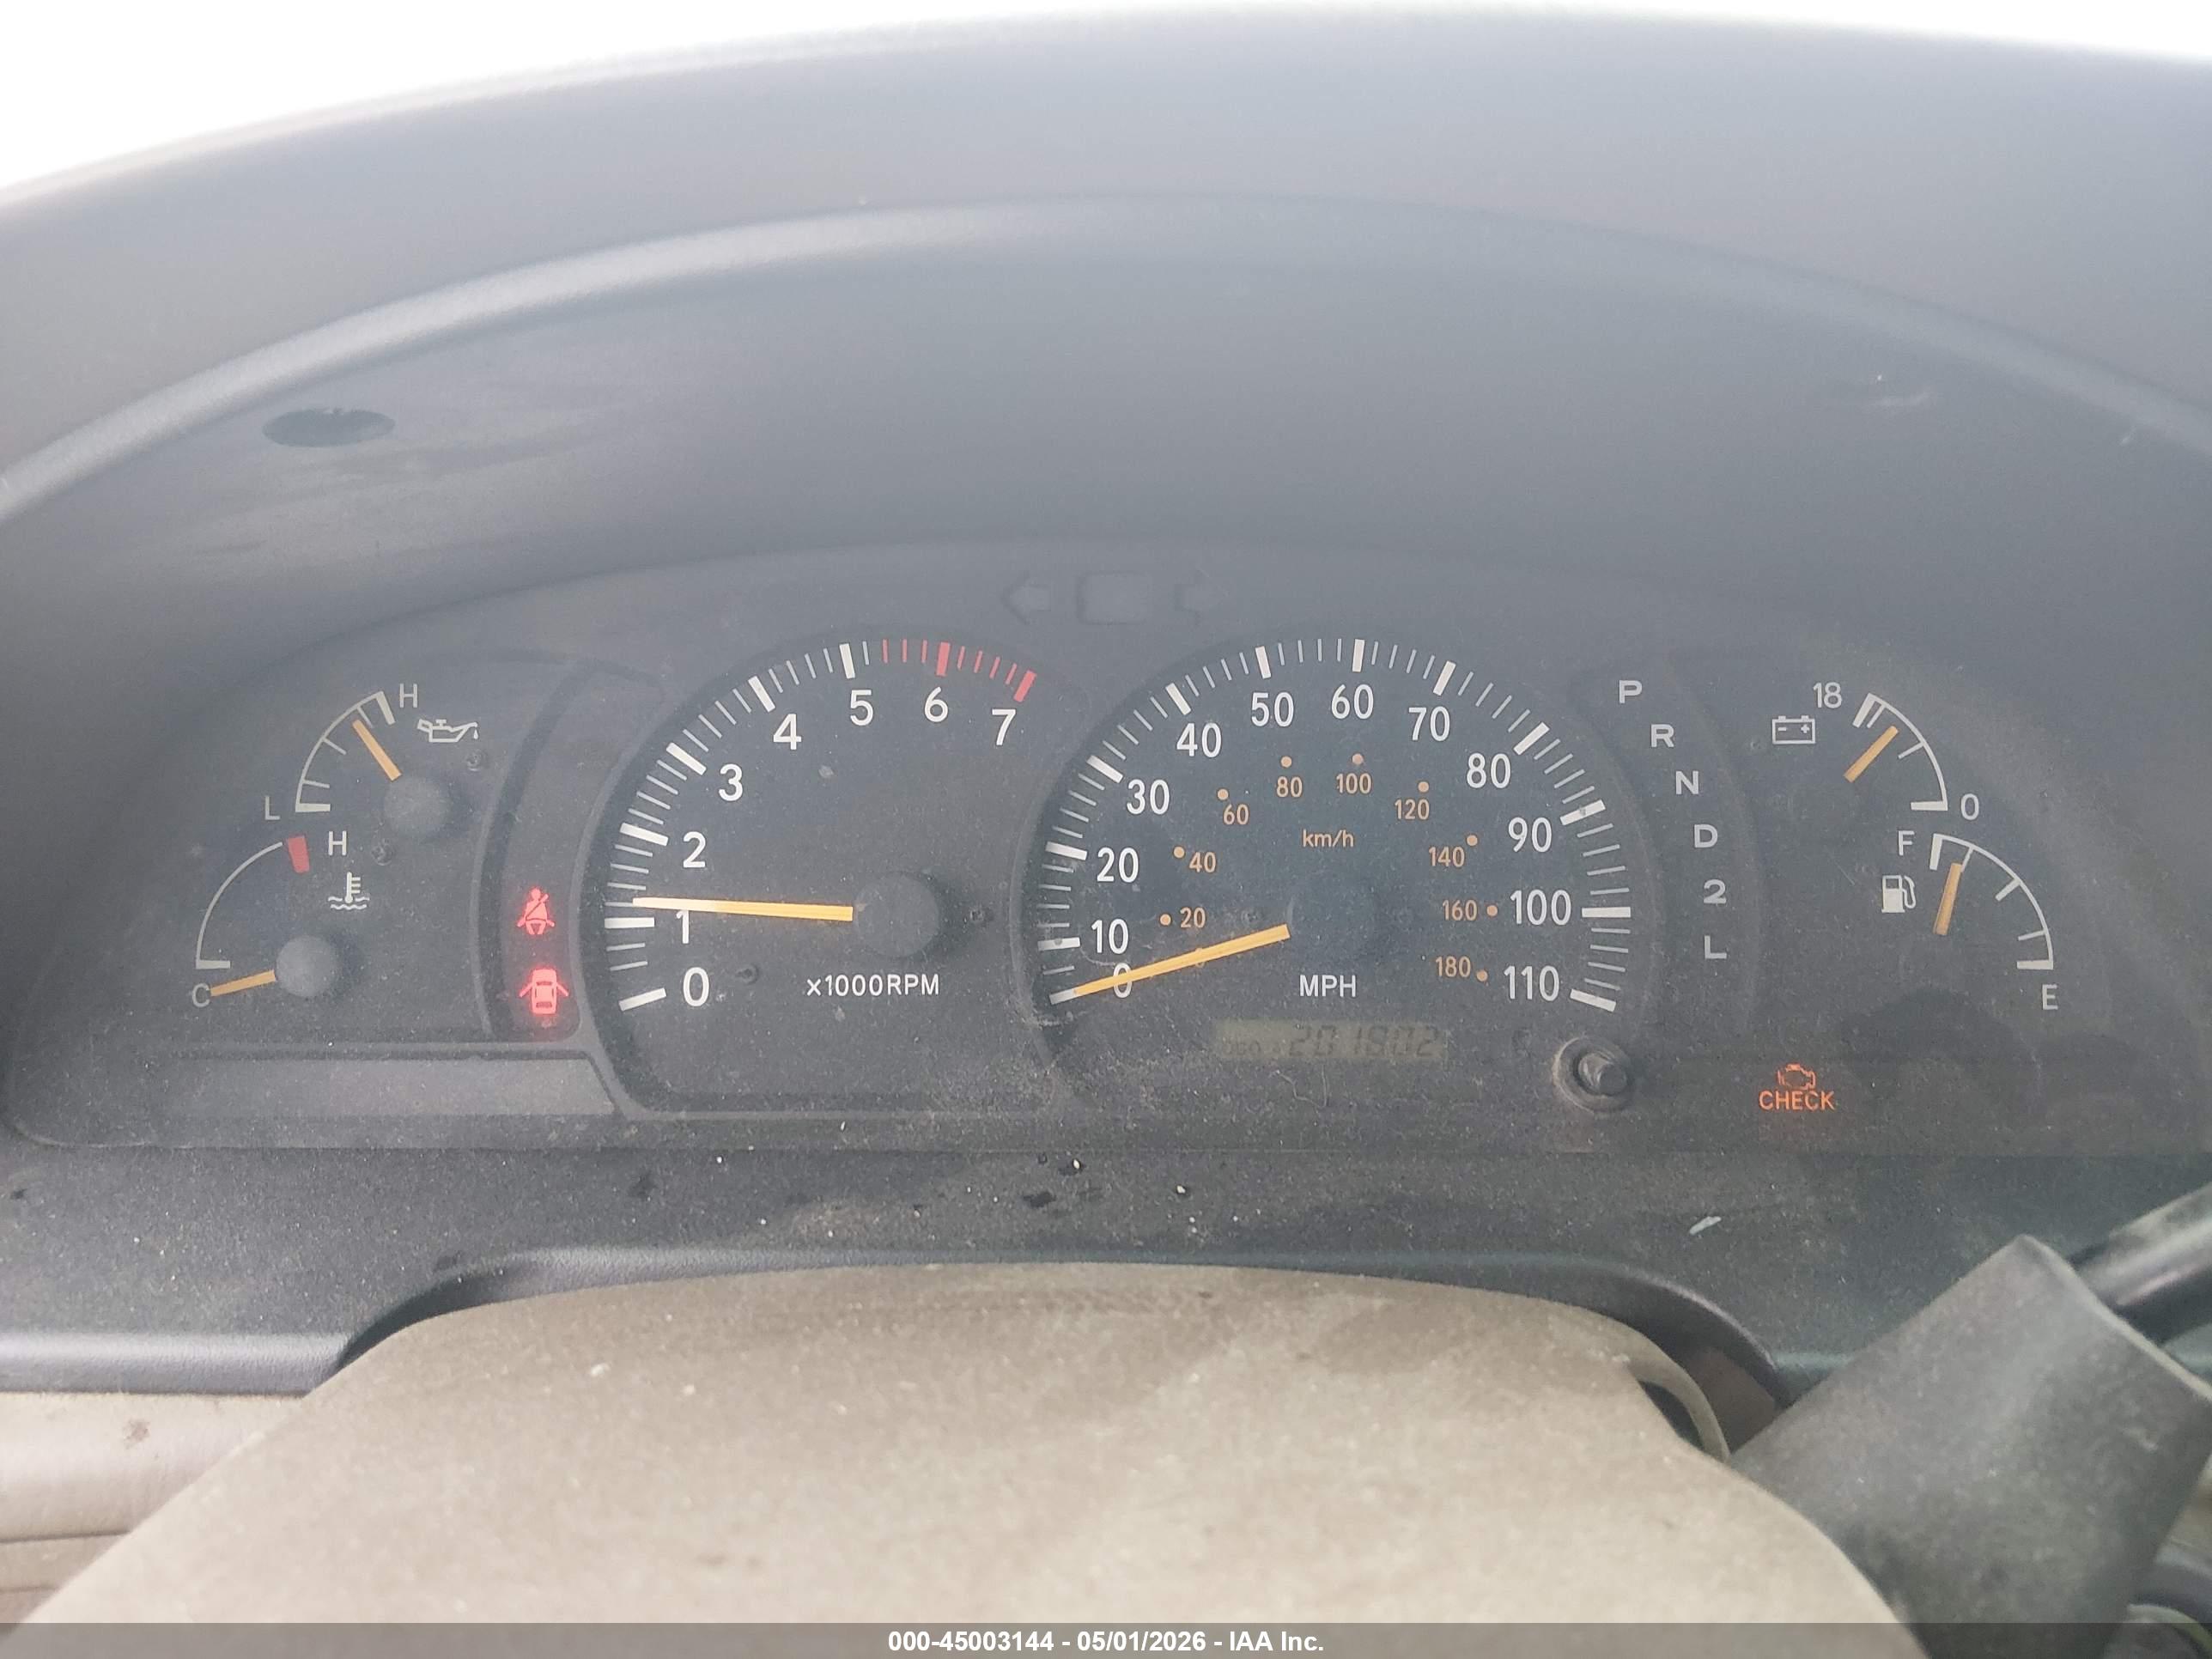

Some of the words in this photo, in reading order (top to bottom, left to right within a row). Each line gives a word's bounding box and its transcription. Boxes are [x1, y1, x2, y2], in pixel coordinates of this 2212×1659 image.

[399, 683, 418, 708] H
[924, 686, 948, 722] 6
[1331, 684, 1374, 720] 60
[1619, 679, 1643, 704] P
[1813, 682, 1843, 708] 18
[850, 690, 873, 726] 5
[1251, 691, 1294, 727] 50
[773, 714, 802, 750] 4
[992, 708, 1016, 745] 7
[1408, 706, 1450, 742] 70
[1650, 724, 1674, 748] R
[1176, 722, 1222, 758] 40
[718, 763, 743, 801] 3
[1336, 773, 1371, 794] 100
[1467, 752, 1511, 789] 80
[1675, 770, 1699, 795] N
[1127, 779, 1170, 815] 30
[1276, 775, 1303, 798] 80
[264, 796, 281, 820] L
[1223, 804, 1249, 825] 60
[1395, 799, 1430, 820] 120
[1960, 793, 1979, 820] 0
[327, 830, 347, 856] H
[1303, 829, 1354, 848] km/h
[1508, 817, 1553, 853] 90
[1693, 823, 1718, 848] D
[1898, 830, 1915, 856] F
[683, 831, 706, 868] 2
[1188, 852, 1216, 873] 40
[1428, 846, 1465, 867] 140
[1097, 847, 1139, 883] 20
[1703, 878, 1727, 904] 2
[1180, 907, 1206, 928] 20
[1442, 899, 1478, 921] 160
[1510, 889, 1571, 926] 100
[674, 908, 691, 945] 1
[1091, 918, 1129, 954] 10
[1704, 935, 1728, 959] L
[1435, 956, 1471, 977] 180
[683, 967, 709, 1007] 0
[806, 974, 939, 997] x1000RPM
[1113, 962, 1133, 999] 0
[1299, 974, 1356, 998] MPH
[1504, 965, 1560, 1001] 110
[191, 982, 210, 1008] C
[2042, 983, 2058, 1011] E
[1759, 1089, 1834, 1110] CHECK
